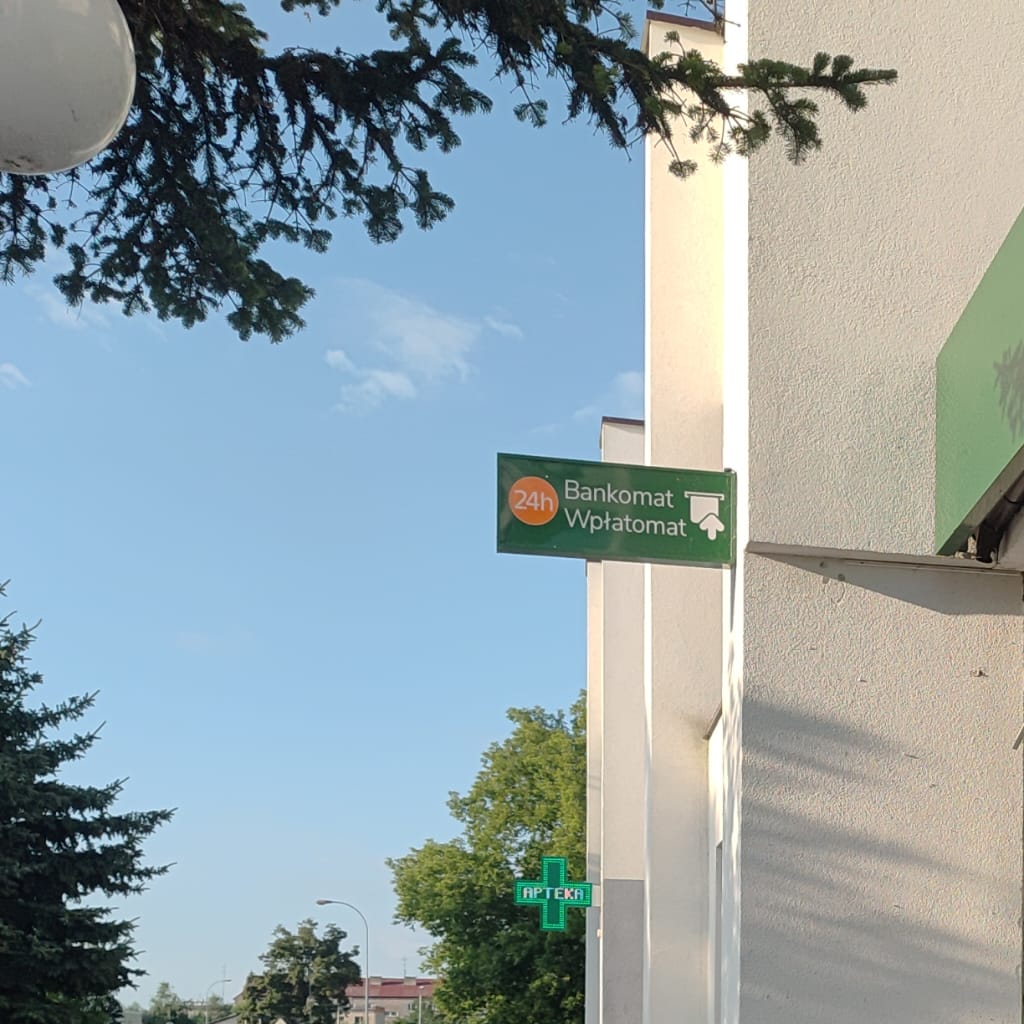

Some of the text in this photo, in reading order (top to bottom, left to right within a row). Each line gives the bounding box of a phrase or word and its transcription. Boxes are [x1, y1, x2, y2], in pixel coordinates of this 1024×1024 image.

[514, 489, 554, 512] 24h
[564, 479, 674, 509] Bankomat
[564, 508, 687, 537] Wpłatomat
[522, 887, 584, 900] APTEKA
